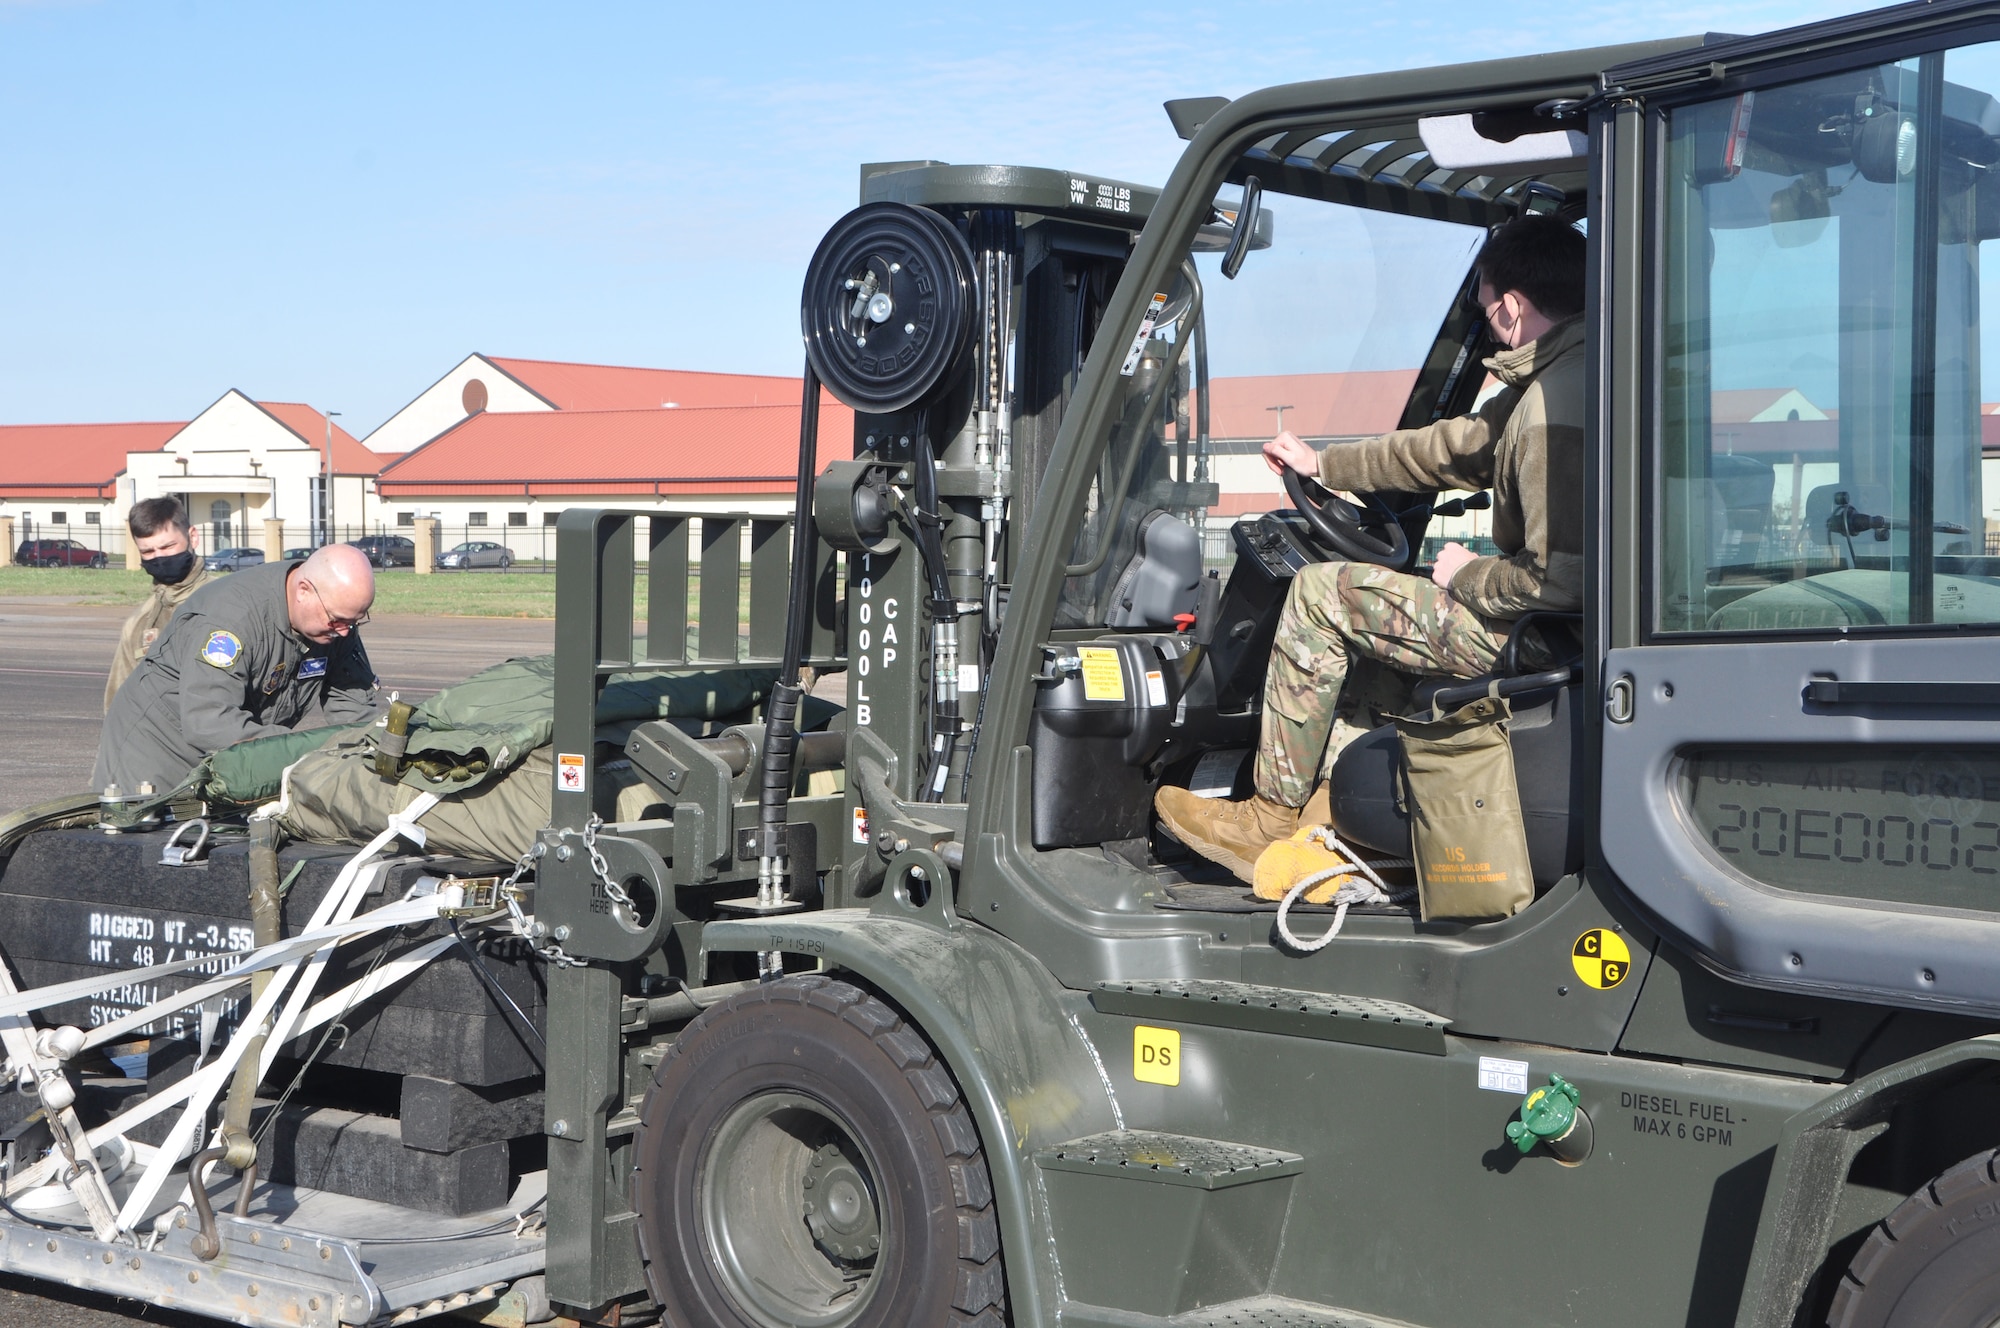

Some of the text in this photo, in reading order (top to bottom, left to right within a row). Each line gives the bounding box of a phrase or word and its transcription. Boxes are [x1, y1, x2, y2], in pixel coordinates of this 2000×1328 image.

[1070, 178, 1089, 193] SWL
[1114, 186, 1131, 200] LBS
[1070, 191, 1085, 205] VW
[1114, 199, 1130, 213] LBS
[882, 597, 899, 669] CAP
[1714, 758, 2000, 801] U.S. AIR FORCE
[1445, 847, 1466, 862] US
[1458, 874, 1476, 883] WITH
[1460, 863, 1491, 872] HOLDER
[590, 899, 609, 915] HERE
[89, 912, 154, 941] RIGGED
[132, 944, 154, 966] 48
[770, 935, 784, 948] TP
[807, 939, 826, 953] PSI
[1584, 936, 1598, 953] C
[1605, 963, 1620, 981] G
[1142, 1044, 1172, 1066] DS
[1621, 1091, 1683, 1116] DIESEL
[1690, 1102, 1735, 1124] FUEL
[1633, 1115, 1732, 1147] MAX 6 GPM
